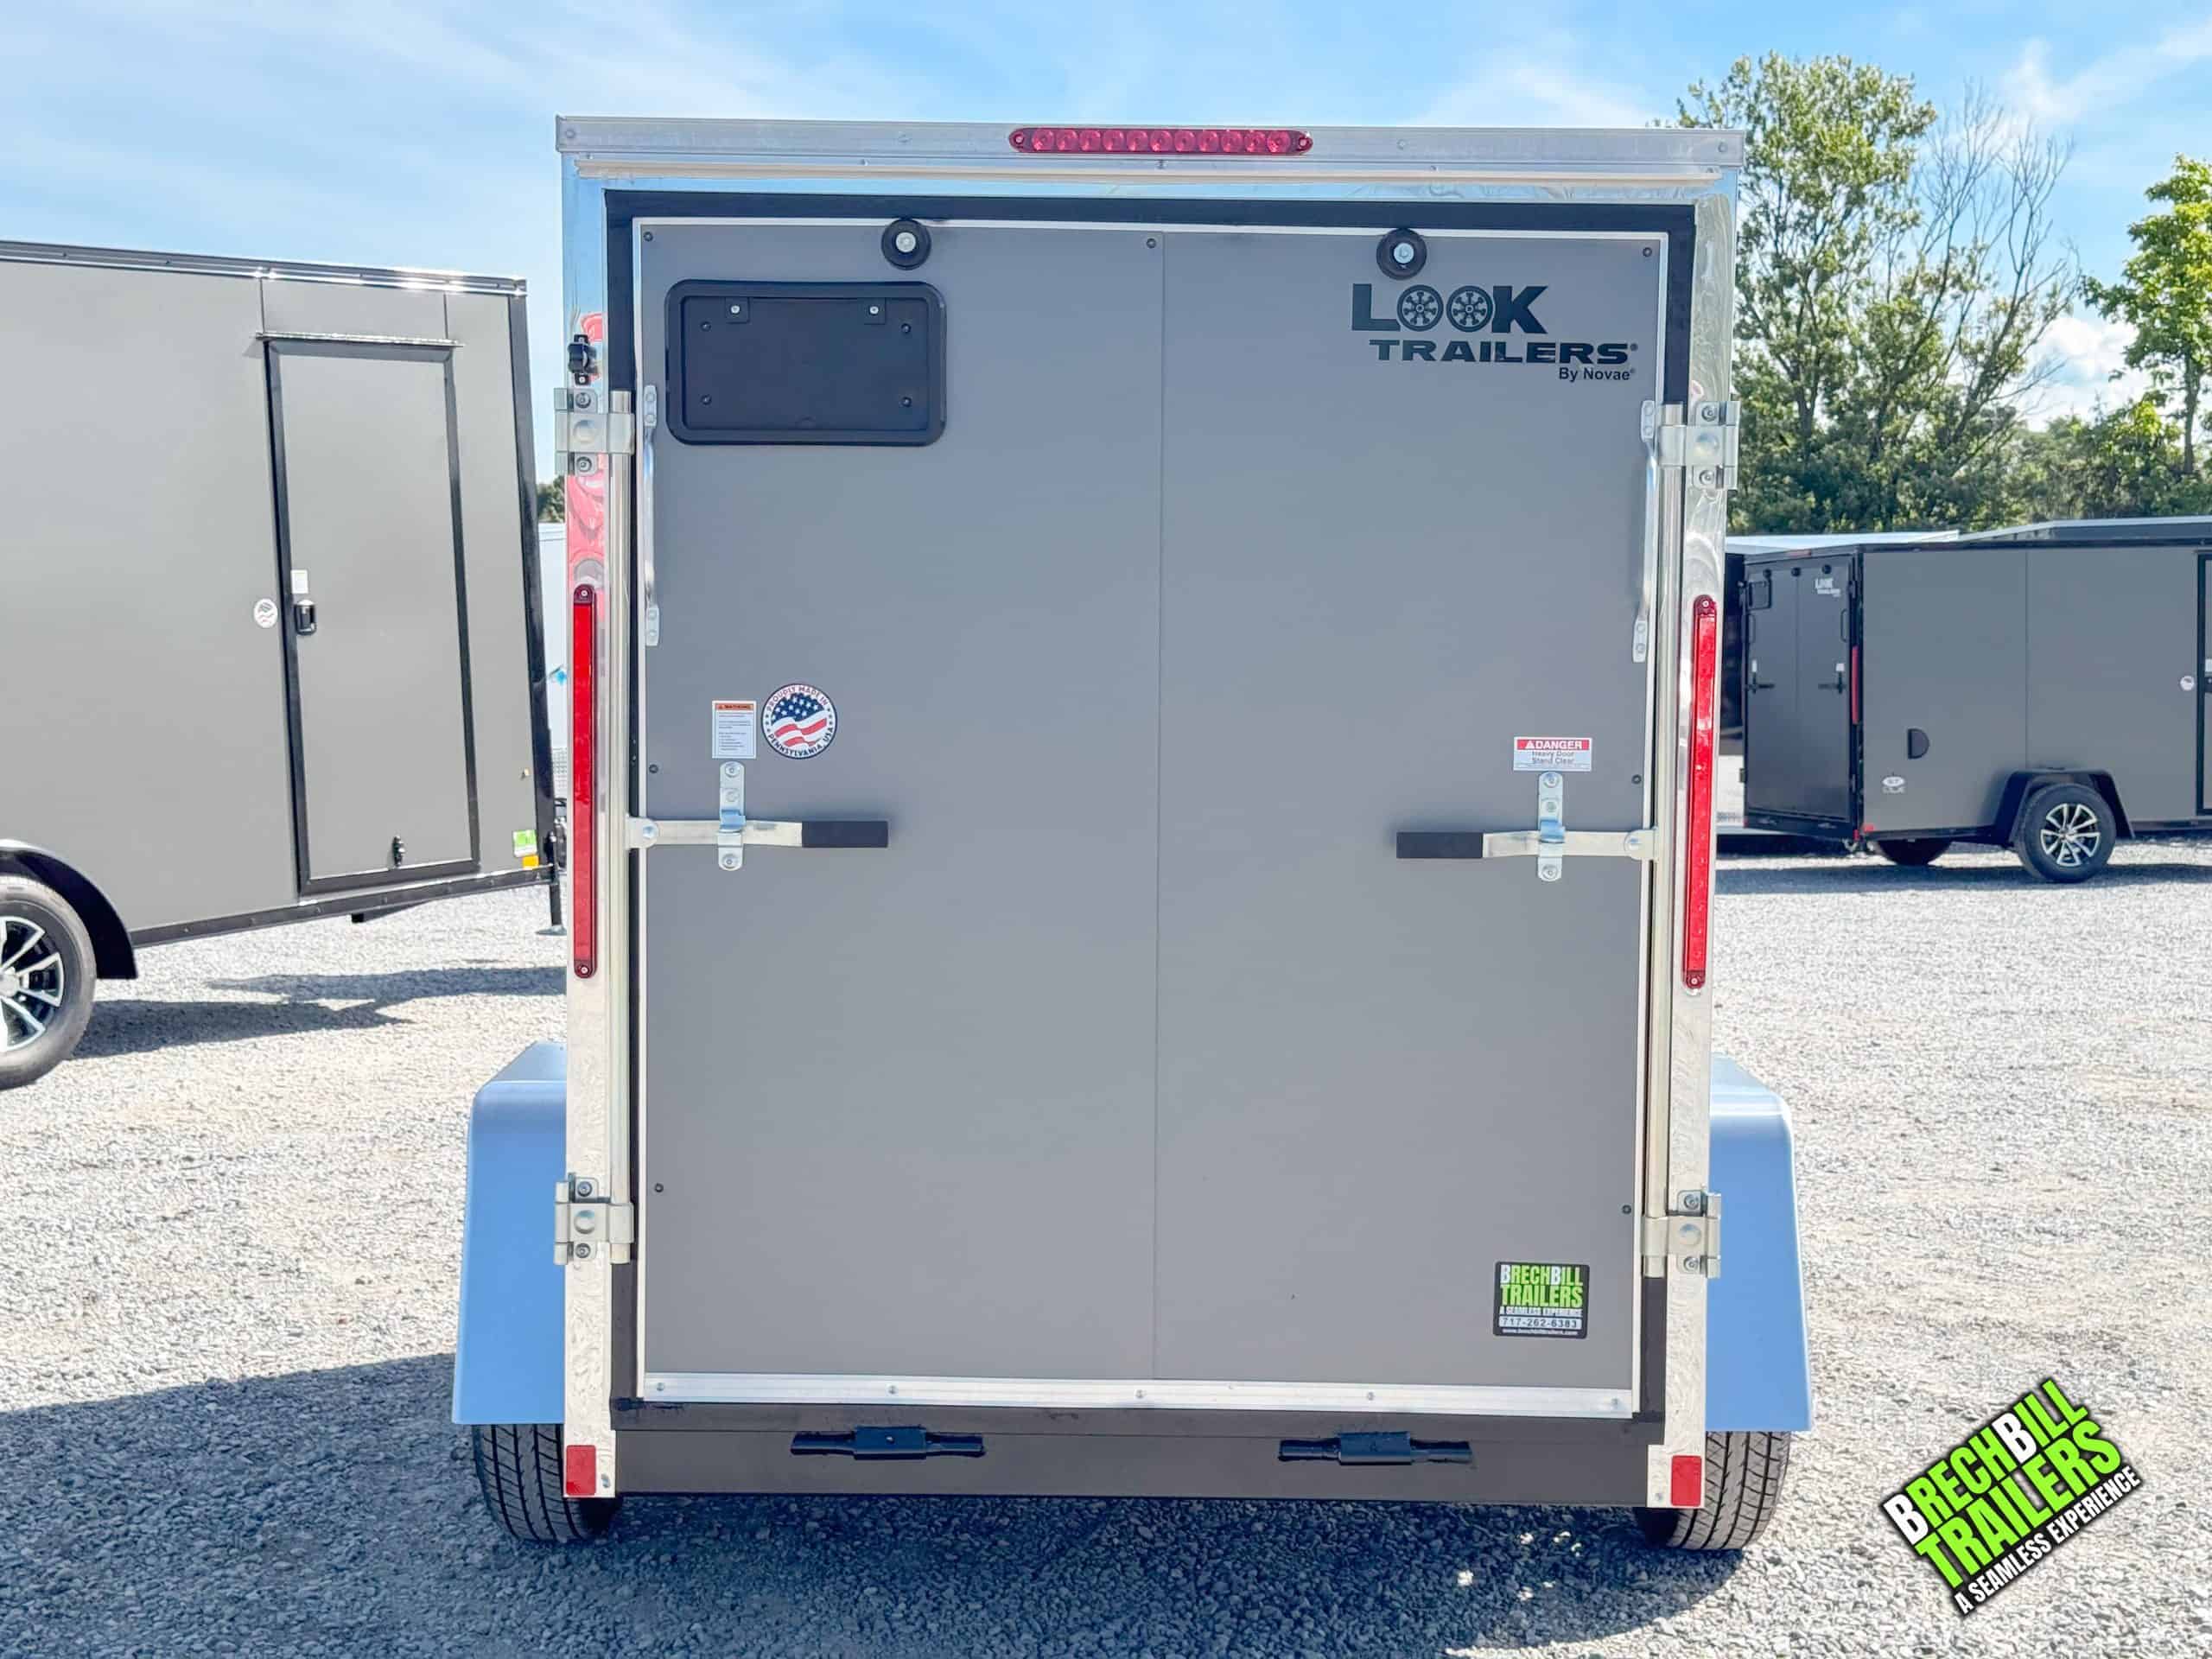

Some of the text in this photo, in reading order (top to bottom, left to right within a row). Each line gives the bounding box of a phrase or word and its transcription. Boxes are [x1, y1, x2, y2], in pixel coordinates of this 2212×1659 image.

[1369, 340, 1629, 365] TRAILERS
[1559, 367, 1630, 382] By Novae
[767, 686, 829, 711] PROUDLY MADE IN
[823, 727, 833, 742] USA
[1535, 741, 1582, 750] DANGER
[1500, 1264, 1584, 1287] BRECHBILL
[1500, 1284, 1584, 1308] TRAILERS
